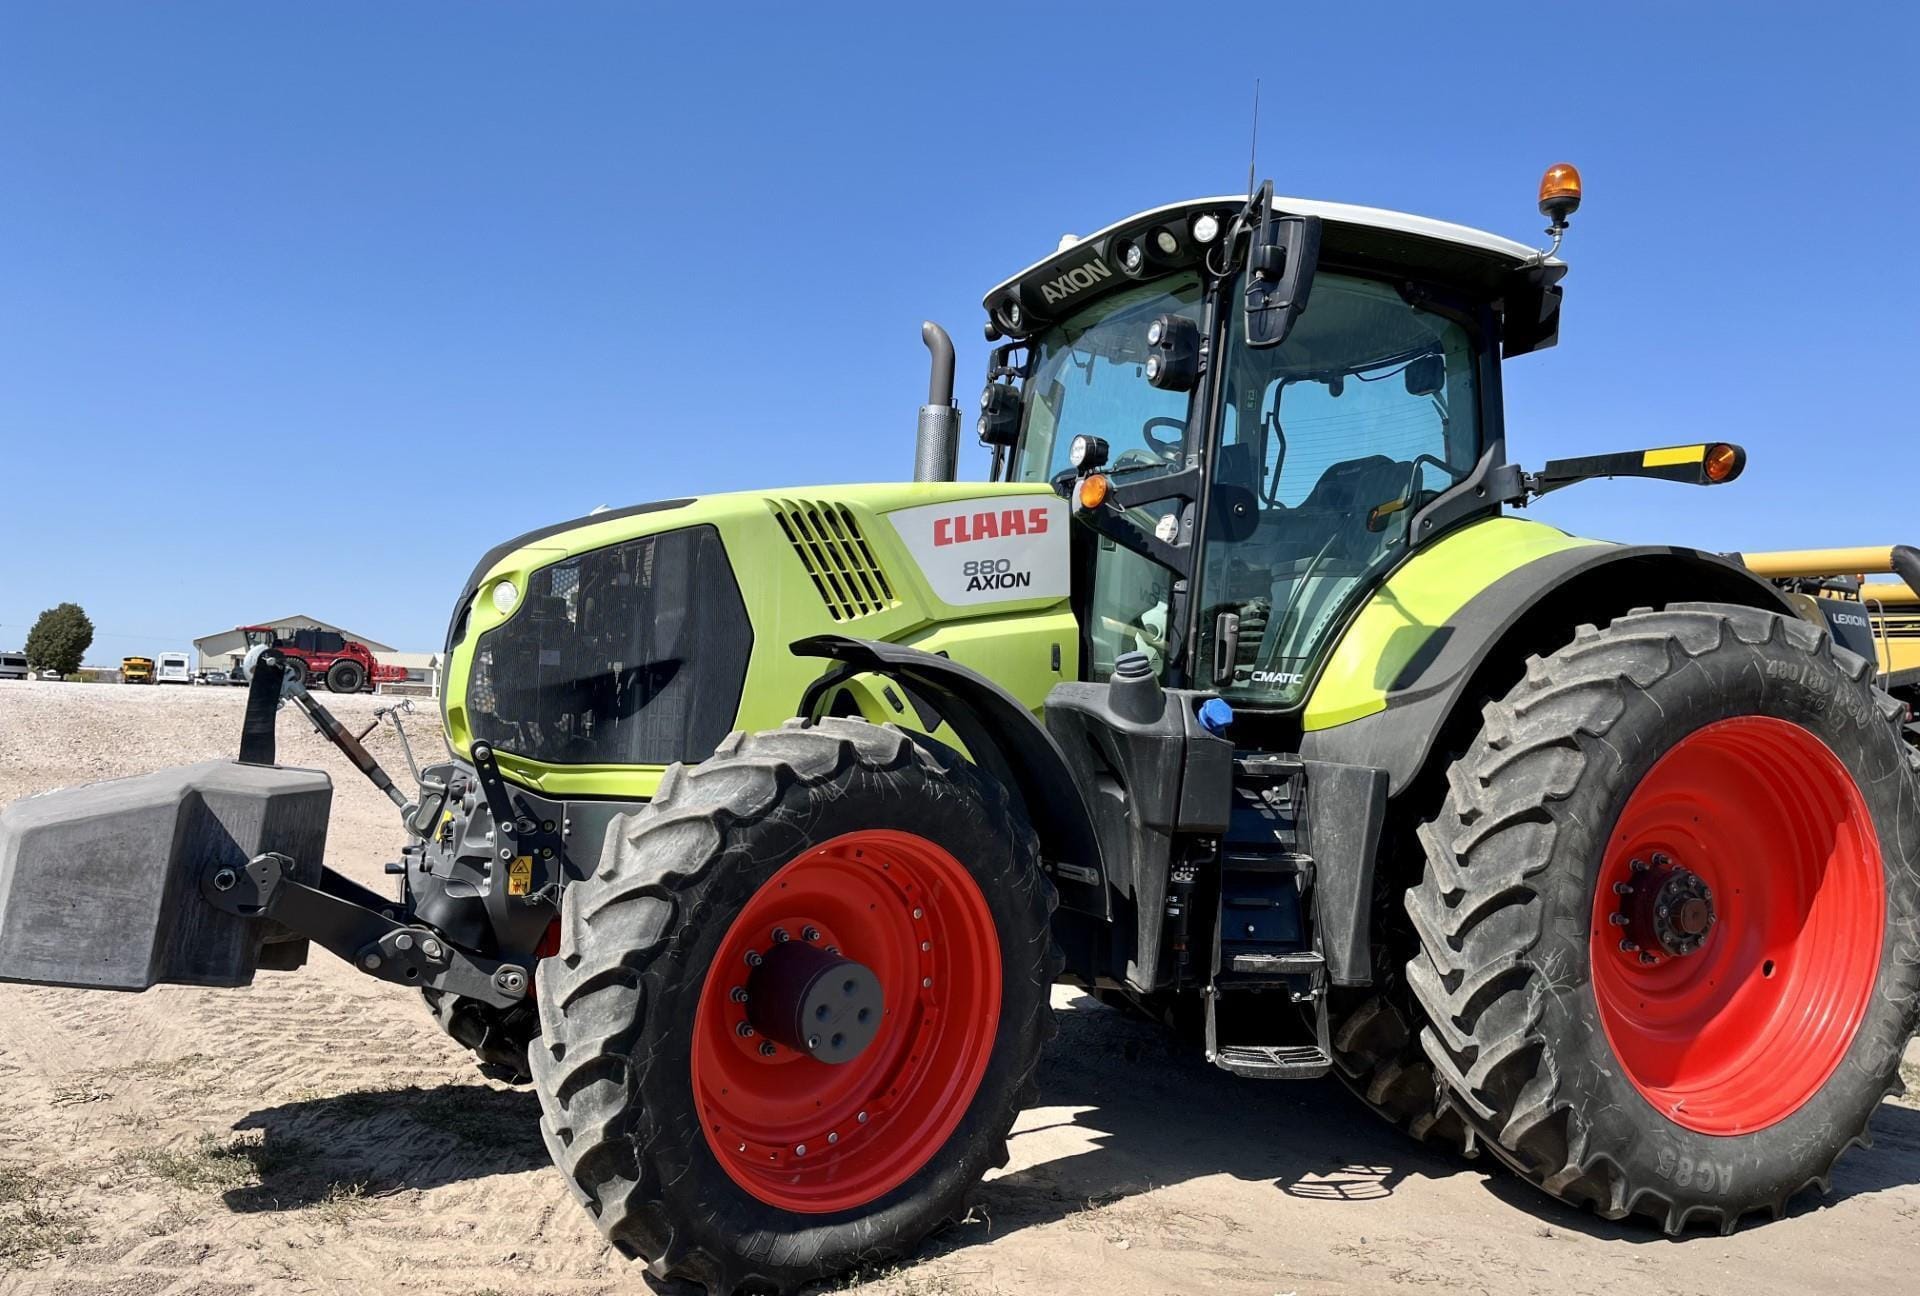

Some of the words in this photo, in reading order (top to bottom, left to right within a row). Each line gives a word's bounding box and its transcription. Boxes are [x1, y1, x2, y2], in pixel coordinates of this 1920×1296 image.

[1041, 258, 1112, 304] AXION
[933, 508, 1048, 546] CLAAS
[963, 559, 1011, 576] 880
[966, 571, 1031, 592] AXION
[1832, 612, 1867, 628] LEXION
[1251, 670, 1304, 684] CMATIC
